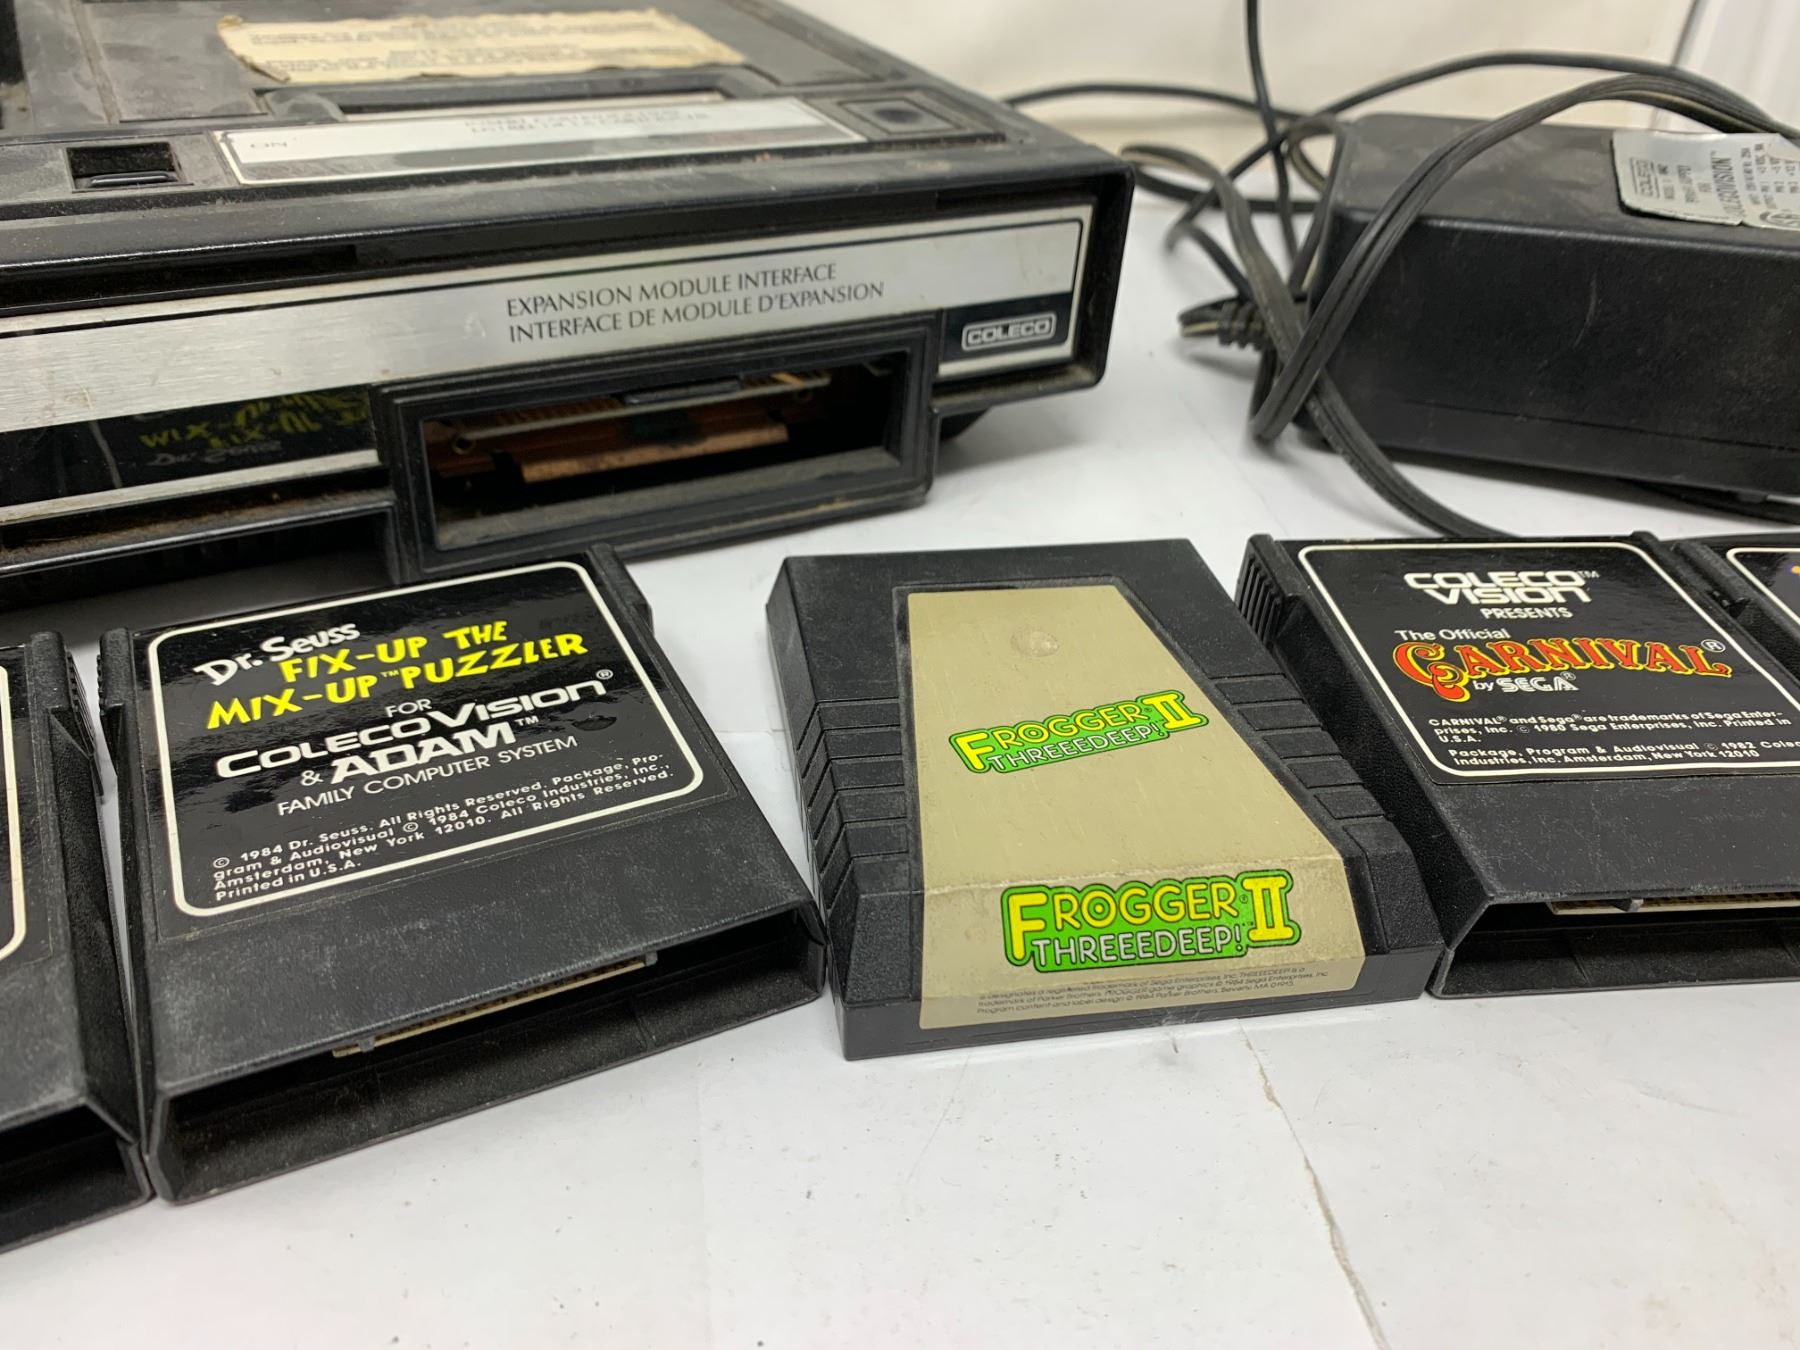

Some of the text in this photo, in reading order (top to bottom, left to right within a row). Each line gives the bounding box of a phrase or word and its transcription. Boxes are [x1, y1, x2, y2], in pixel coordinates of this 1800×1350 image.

[507, 263, 837, 317] EXPANSION MODULE INTERFACE
[509, 281, 885, 344] INTERFACE DE MODULE D'EXPANSION
[967, 319, 1051, 345] COLECO
[1423, 587, 1592, 605] VISION
[1480, 607, 1574, 619] PRESENTS
[194, 623, 361, 686] Dr. Seuss
[279, 620, 508, 683] FIX-UP THE
[1394, 628, 1511, 641] The Official
[401, 632, 590, 690] PUZZLER
[1473, 680, 1495, 691] by
[385, 698, 432, 718] FOR
[1434, 727, 1483, 736] prises,
[1485, 725, 1514, 733] Inc.
[1534, 724, 1567, 732] 1980
[1569, 722, 1607, 733] Sega
[1612, 720, 1693, 731] Enterprises,
[1694, 720, 1722, 728] Inc.
[1725, 718, 1775, 728] Printed
[1777, 717, 1792, 725] in
[1508, 715, 1537, 724] and
[1583, 714, 1608, 722] are
[1607, 713, 1690, 722] trademarks
[1691, 712, 1704, 720] of
[1703, 711, 1742, 721] Sega
[1741, 711, 1783, 719] Enter-
[955, 701, 1149, 771] FROGGER
[987, 723, 1165, 771] THREEEDEEP!
[1438, 734, 1482, 743] U.S.A.
[1525, 747, 1590, 757] Program
[1595, 745, 1608, 753] &
[1613, 743, 1700, 753] Audiovisual
[1721, 741, 1756, 749] 1982
[1759, 740, 1800, 749] Colec
[277, 735, 579, 816] FAMILY COMPUTER SYSTEM
[1453, 749, 1761, 766] Industries, Inc. Amsterdam, New York 12010
[300, 770, 324, 787] &
[213, 861, 263, 881] gram
[270, 856, 282, 866] &
[290, 828, 395, 861] Audiovisual
[429, 808, 469, 826] 1984
[481, 793, 537, 813] Coleco
[542, 771, 630, 798] Industries,
[240, 844, 283, 861] 1984
[288, 838, 313, 850] Dr.
[318, 824, 374, 843] Seuss.
[379, 815, 401, 828] All
[406, 802, 460, 822] Rights
[465, 782, 547, 807] Reserved.
[552, 762, 630, 786] Package,
[631, 753, 664, 767] Pro-
[214, 770, 674, 890] Amsterdam, New York 12010. All Rights Reserved.
[215, 860, 362, 901] Printed in U.S.A.
[1008, 881, 1239, 961] FROGGER
[1031, 926, 1243, 967] THREEEDEEP!
